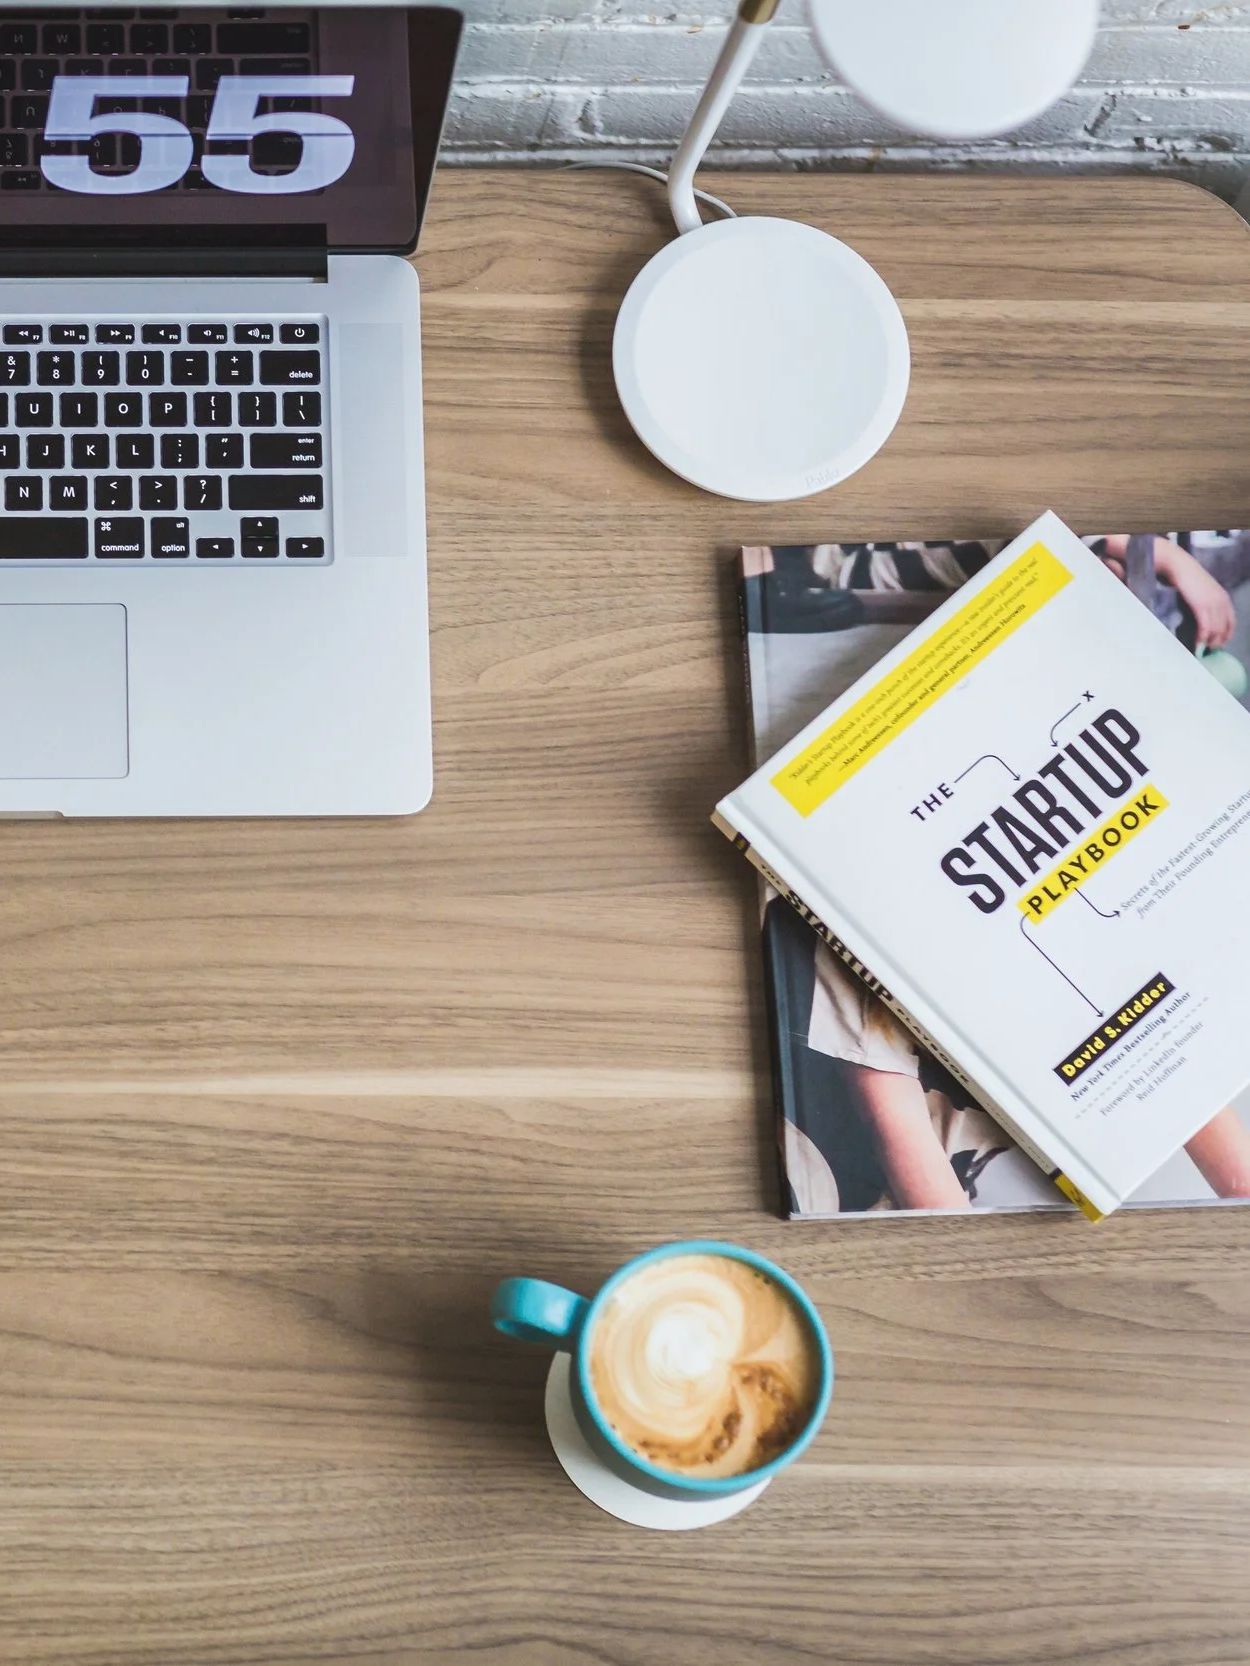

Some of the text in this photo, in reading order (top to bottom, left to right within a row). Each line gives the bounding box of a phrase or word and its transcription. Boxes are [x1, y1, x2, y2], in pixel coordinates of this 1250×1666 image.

[40, 75, 356, 195] 55
[6, 355, 16, 366] &
[7, 368, 16, 380] 7
[52, 368, 61, 380] 8
[97, 368, 105, 380] 9
[141, 368, 150, 379] 0
[288, 370, 314, 379] delete
[29, 403, 40, 415] U
[77, 403, 82, 415] I
[118, 402, 129, 415] O
[164, 402, 173, 414] P
[42, 444, 49, 457] J
[86, 444, 96, 456] K
[131, 444, 140, 456] L
[291, 454, 316, 462] return
[19, 486, 30, 498] N
[62, 486, 76, 498] M
[298, 494, 316, 504] shift
[199, 479, 207, 490] ?
[175, 521, 185, 529] alt
[100, 543, 140, 552] command
[160, 543, 186, 554] option
[910, 782, 955, 823] THE
[940, 708, 1150, 914] STARTUP
[1027, 794, 1161, 914] PLAYBOOK
[1120, 885, 1150, 911] Secrets
[1149, 873, 1159, 887] of
[1156, 865, 1170, 879] the
[1136, 898, 1157, 920] from
[1153, 879, 1176, 899] Their
[1174, 847, 1214, 881] Founding
[784, 889, 894, 1004] STARTUP
[896, 1007, 970, 1086] PLAYBOOK
[1061, 982, 1166, 1077] David S. Kidder
[1070, 992, 1190, 1101] New York Times Bestselling Author
[1099, 1021, 1204, 1117] Foreword by LinkedIn founder
[1153, 1056, 1187, 1086] Hoffman
